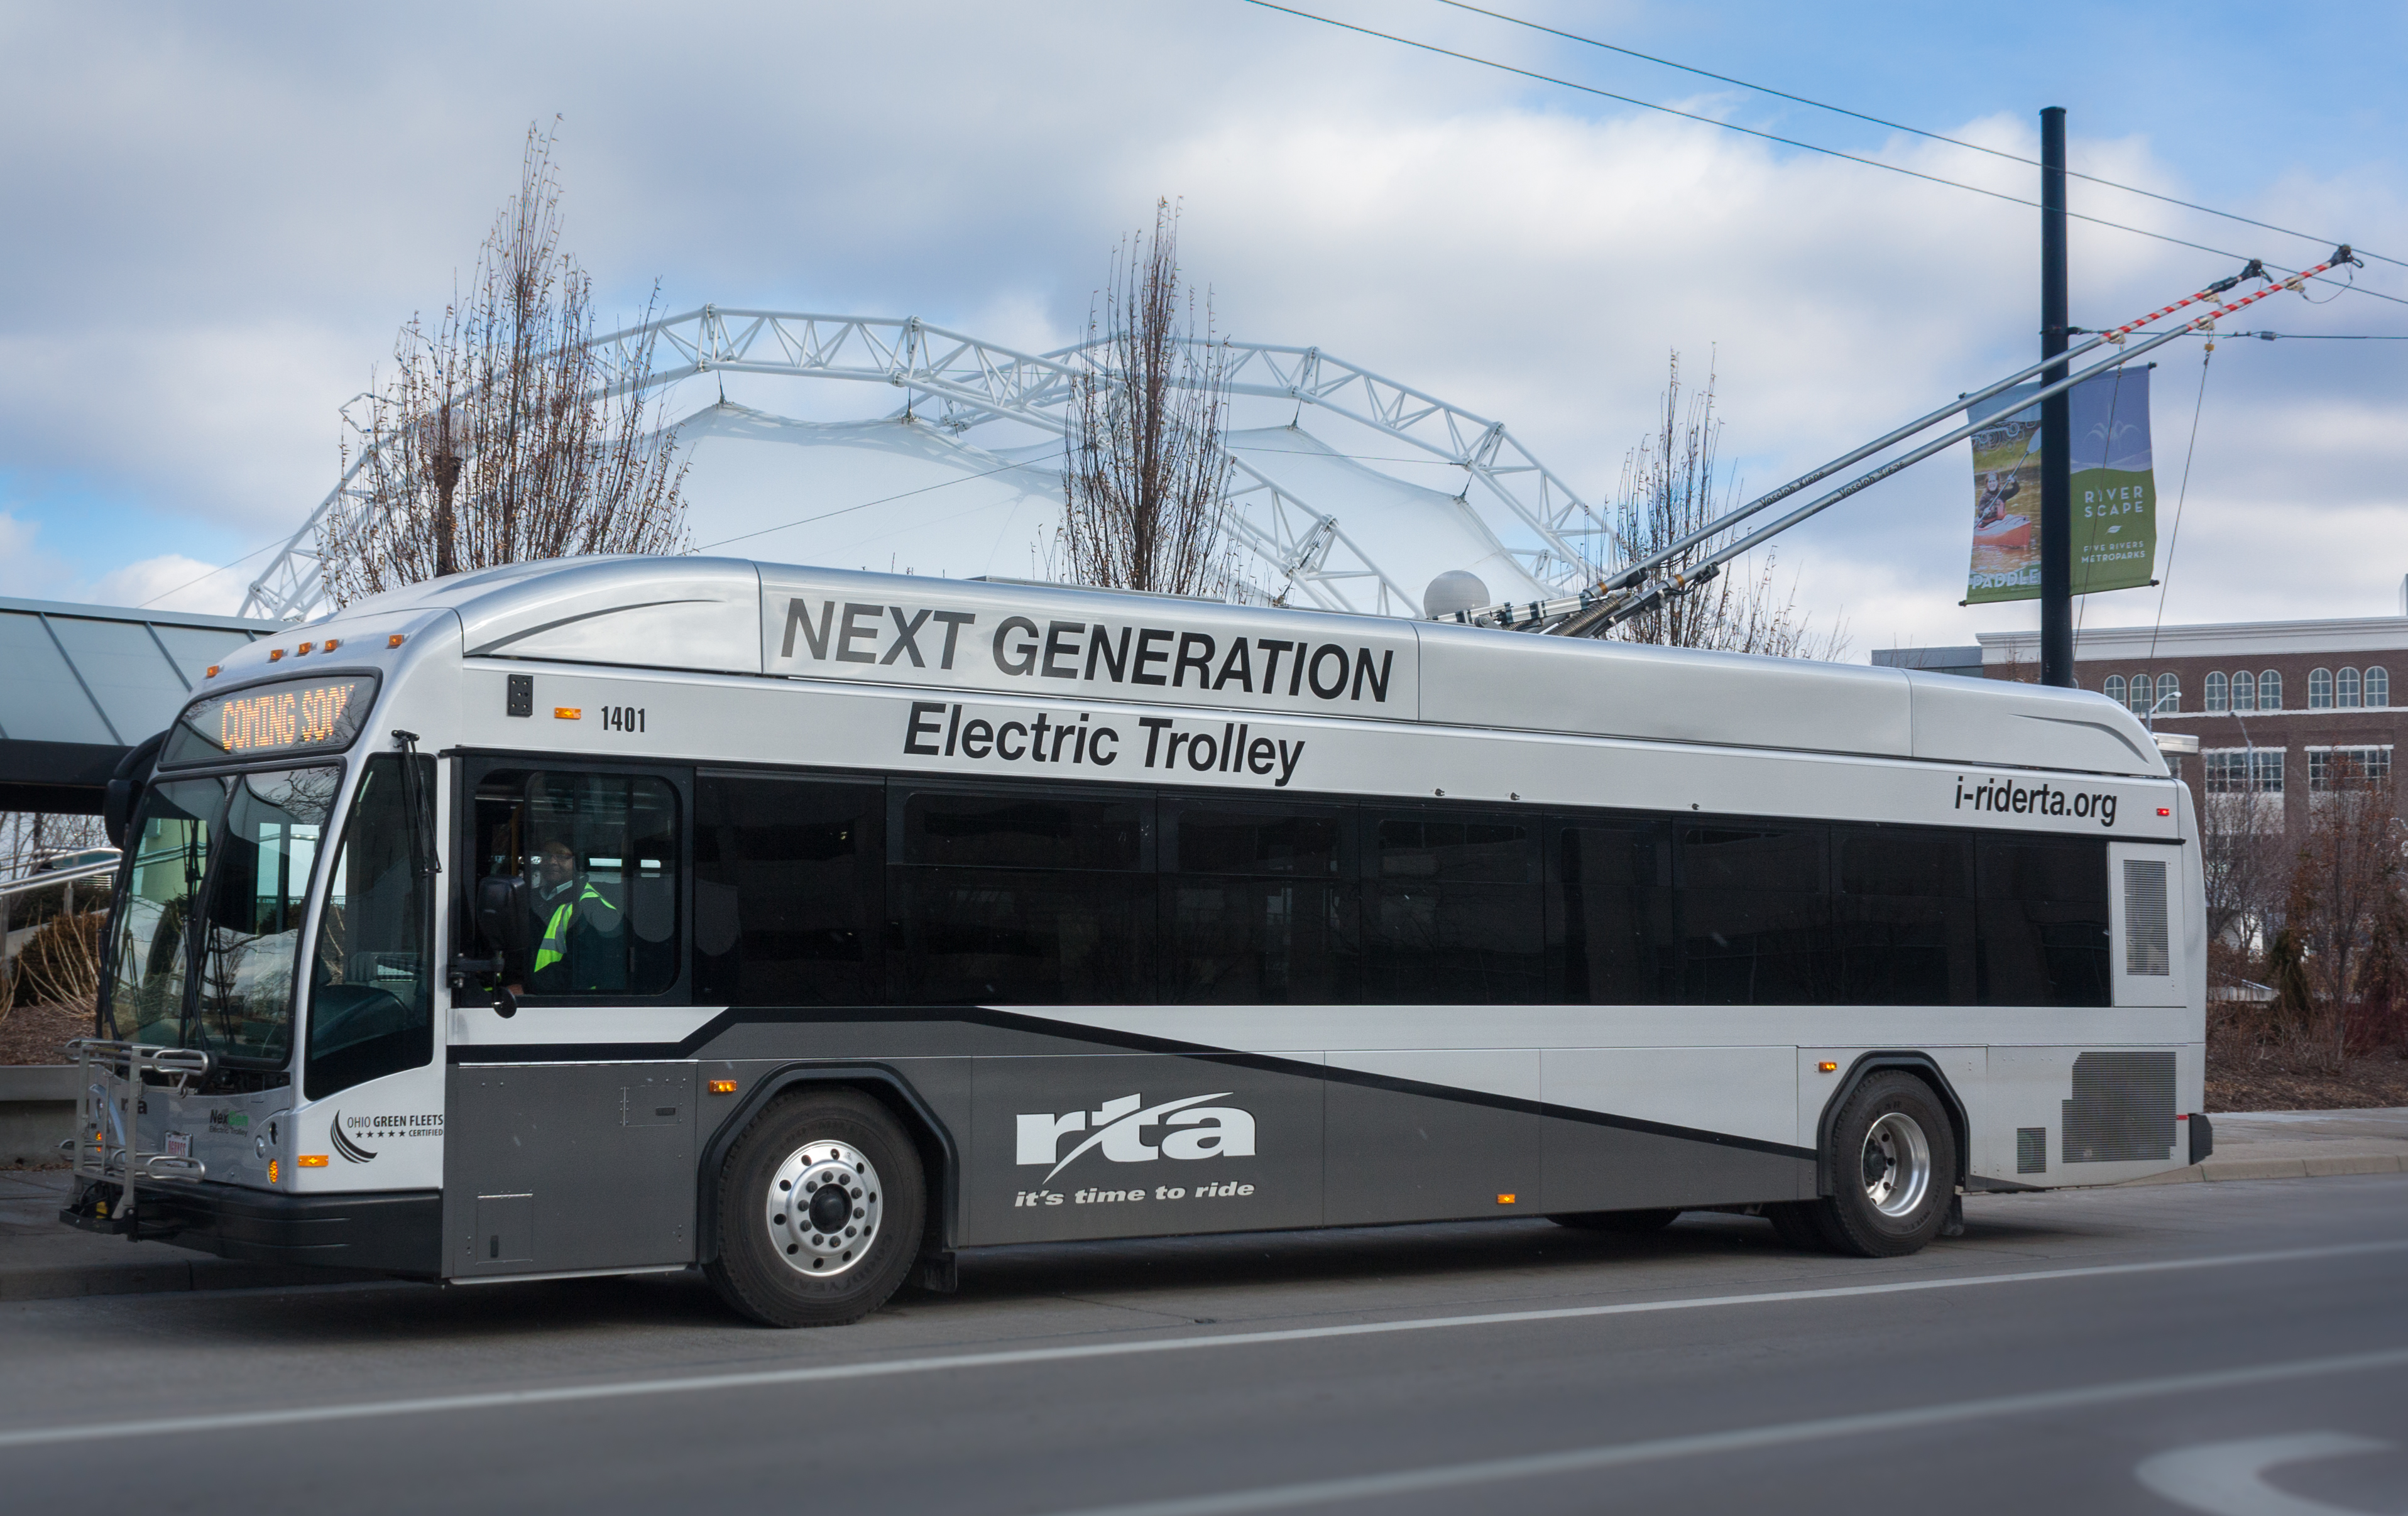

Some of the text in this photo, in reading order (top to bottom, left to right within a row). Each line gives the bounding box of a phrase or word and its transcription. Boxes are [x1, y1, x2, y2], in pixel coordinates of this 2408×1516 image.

[2084, 486, 2143, 503] RIVER
[2084, 501, 2143, 518] SCAPE
[2081, 550, 2146, 563] METROPARKS
[2083, 540, 2144, 552] FIVE RIVERS
[1972, 568, 2039, 590] PADDLE
[780, 598, 1394, 702] NEXT GENERATION
[221, 693, 295, 750] COMING
[600, 706, 645, 733] 1401
[904, 702, 1306, 788] Electric Trolley
[1954, 775, 2118, 827] i-riderta.org
[347, 1114, 444, 1128] OHIO GREEN FLEETS
[408, 1128, 444, 1137] CERTIFIED
[1016, 1092, 1256, 1186] rta
[1015, 1181, 1256, 1208] it's time to ride
